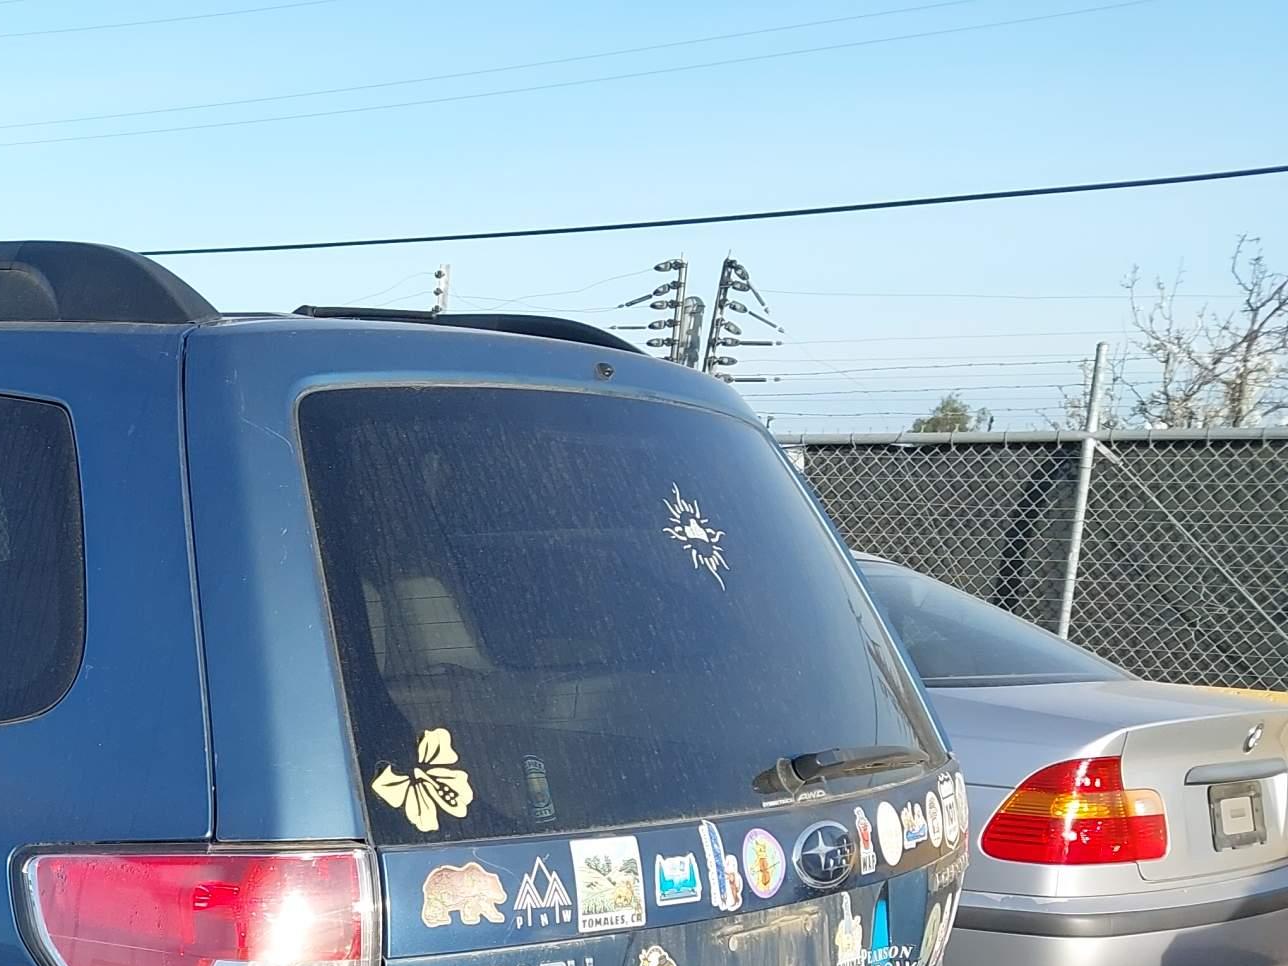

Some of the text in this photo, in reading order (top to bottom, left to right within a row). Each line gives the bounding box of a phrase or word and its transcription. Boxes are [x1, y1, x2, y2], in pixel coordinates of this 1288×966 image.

[797, 789, 826, 802] AWD
[582, 913, 643, 929] TOMALES, CA
[861, 945, 914, 964] PEARSON
